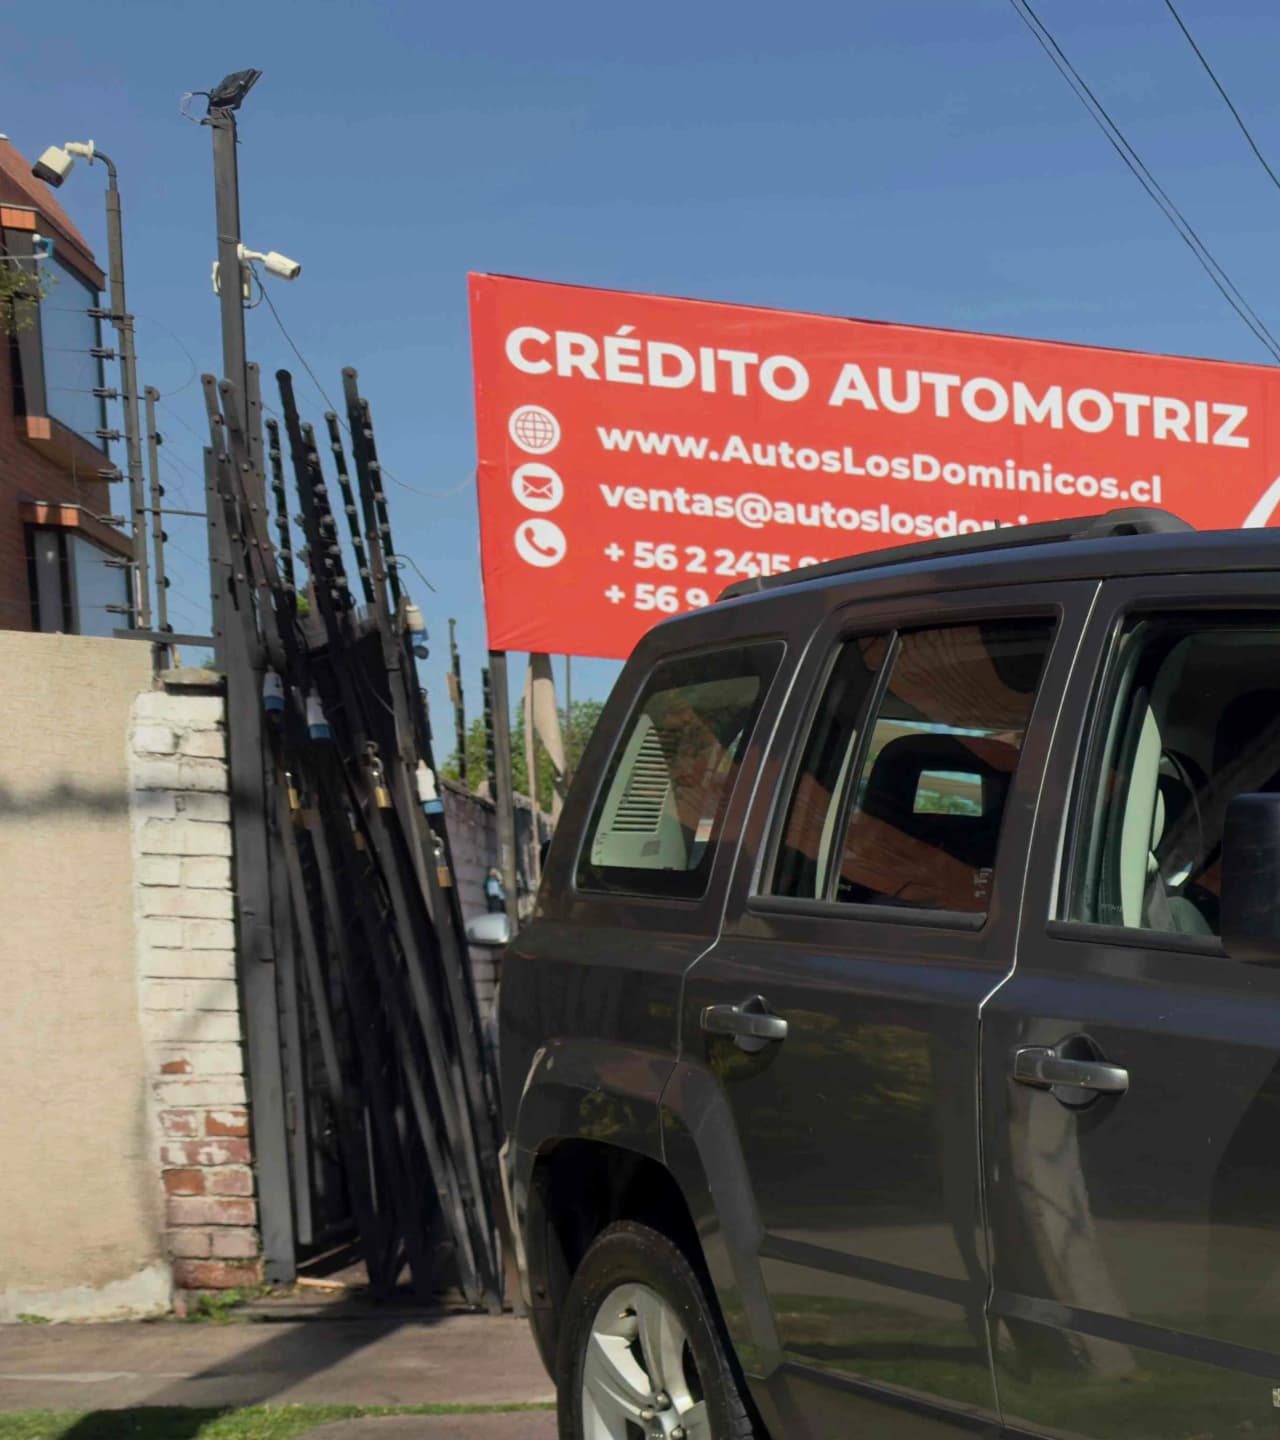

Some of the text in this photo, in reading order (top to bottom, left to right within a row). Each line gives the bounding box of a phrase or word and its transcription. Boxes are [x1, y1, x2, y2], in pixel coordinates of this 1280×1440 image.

[505, 325, 1250, 449] CRÉDITO AUTOMOTRIZ
[597, 426, 1161, 503] www.AutosLosDominicos.cl
[633, 541, 679, 571] 56
[685, 546, 708, 574] 2
[714, 549, 791, 578] 2415
[634, 583, 679, 613] 56
